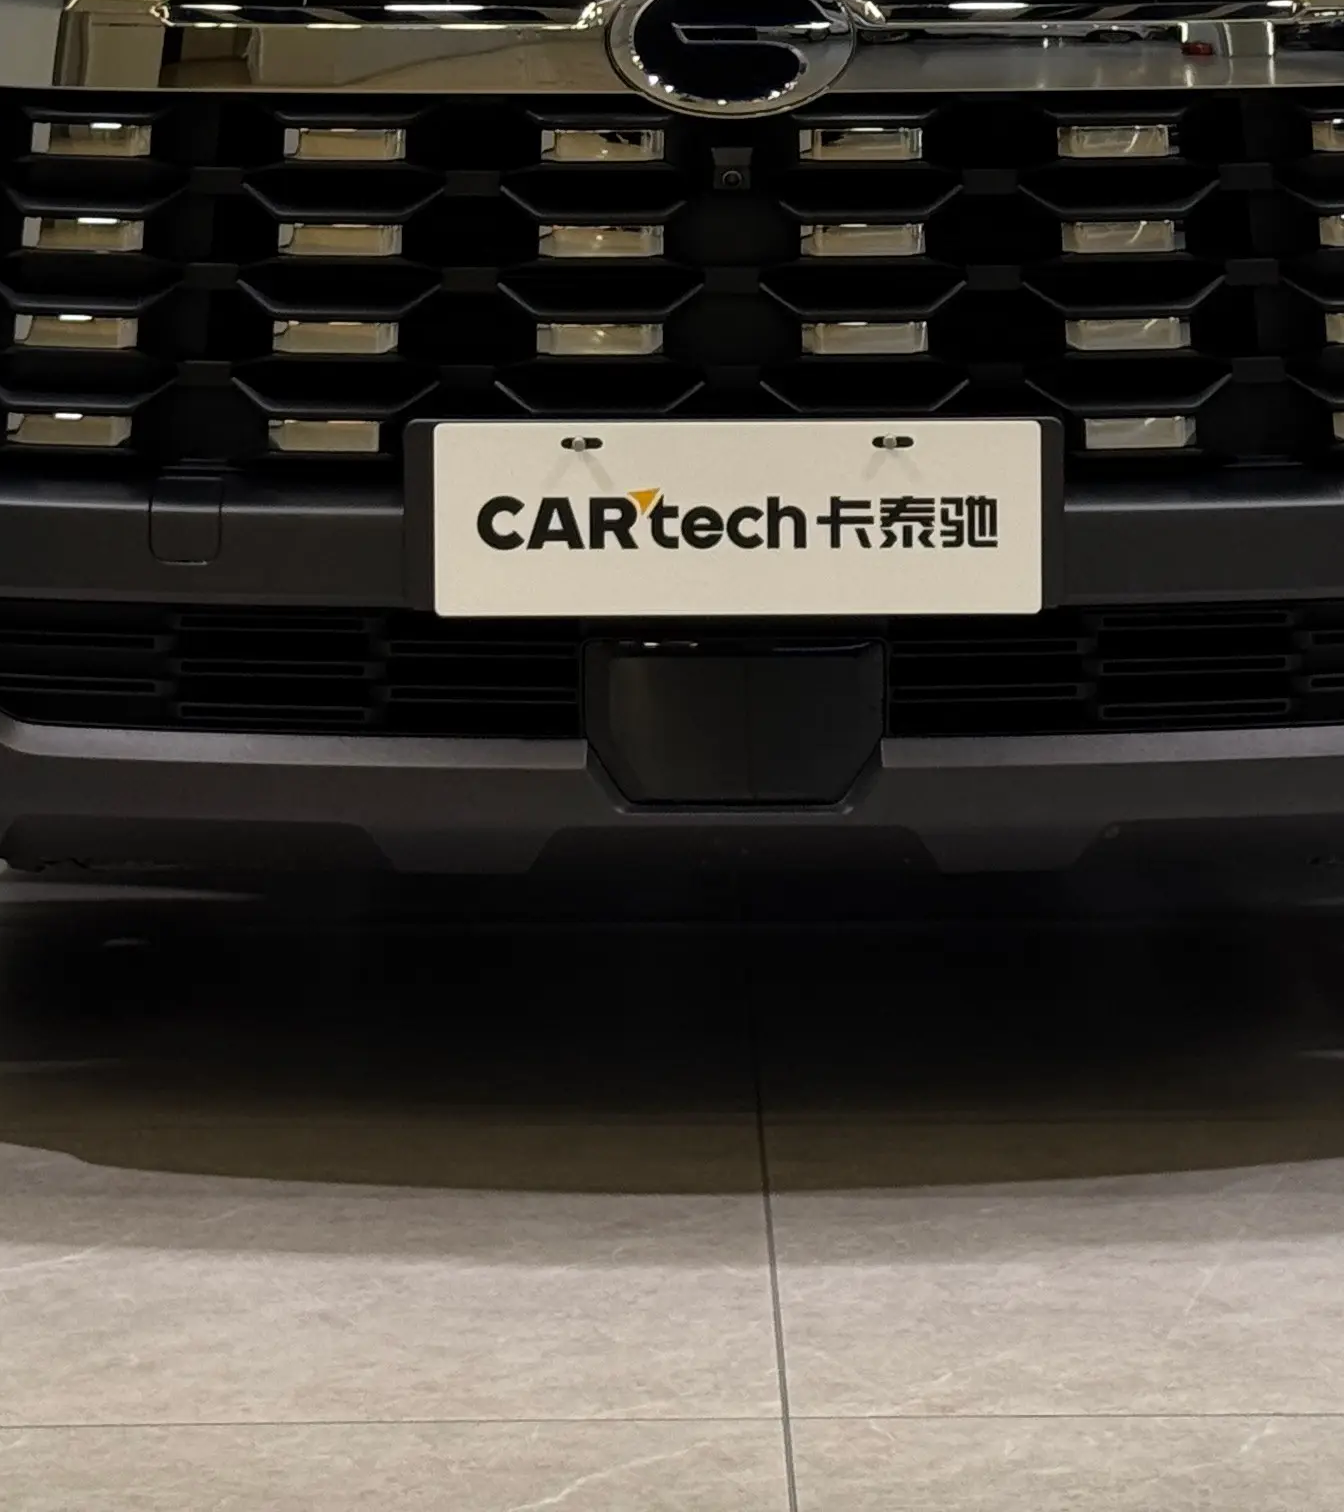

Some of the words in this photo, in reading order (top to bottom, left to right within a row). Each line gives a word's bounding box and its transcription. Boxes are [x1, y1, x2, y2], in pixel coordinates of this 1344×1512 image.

[476, 488, 807, 551] CARtech
[816, 495, 999, 549] 卡泰驰
